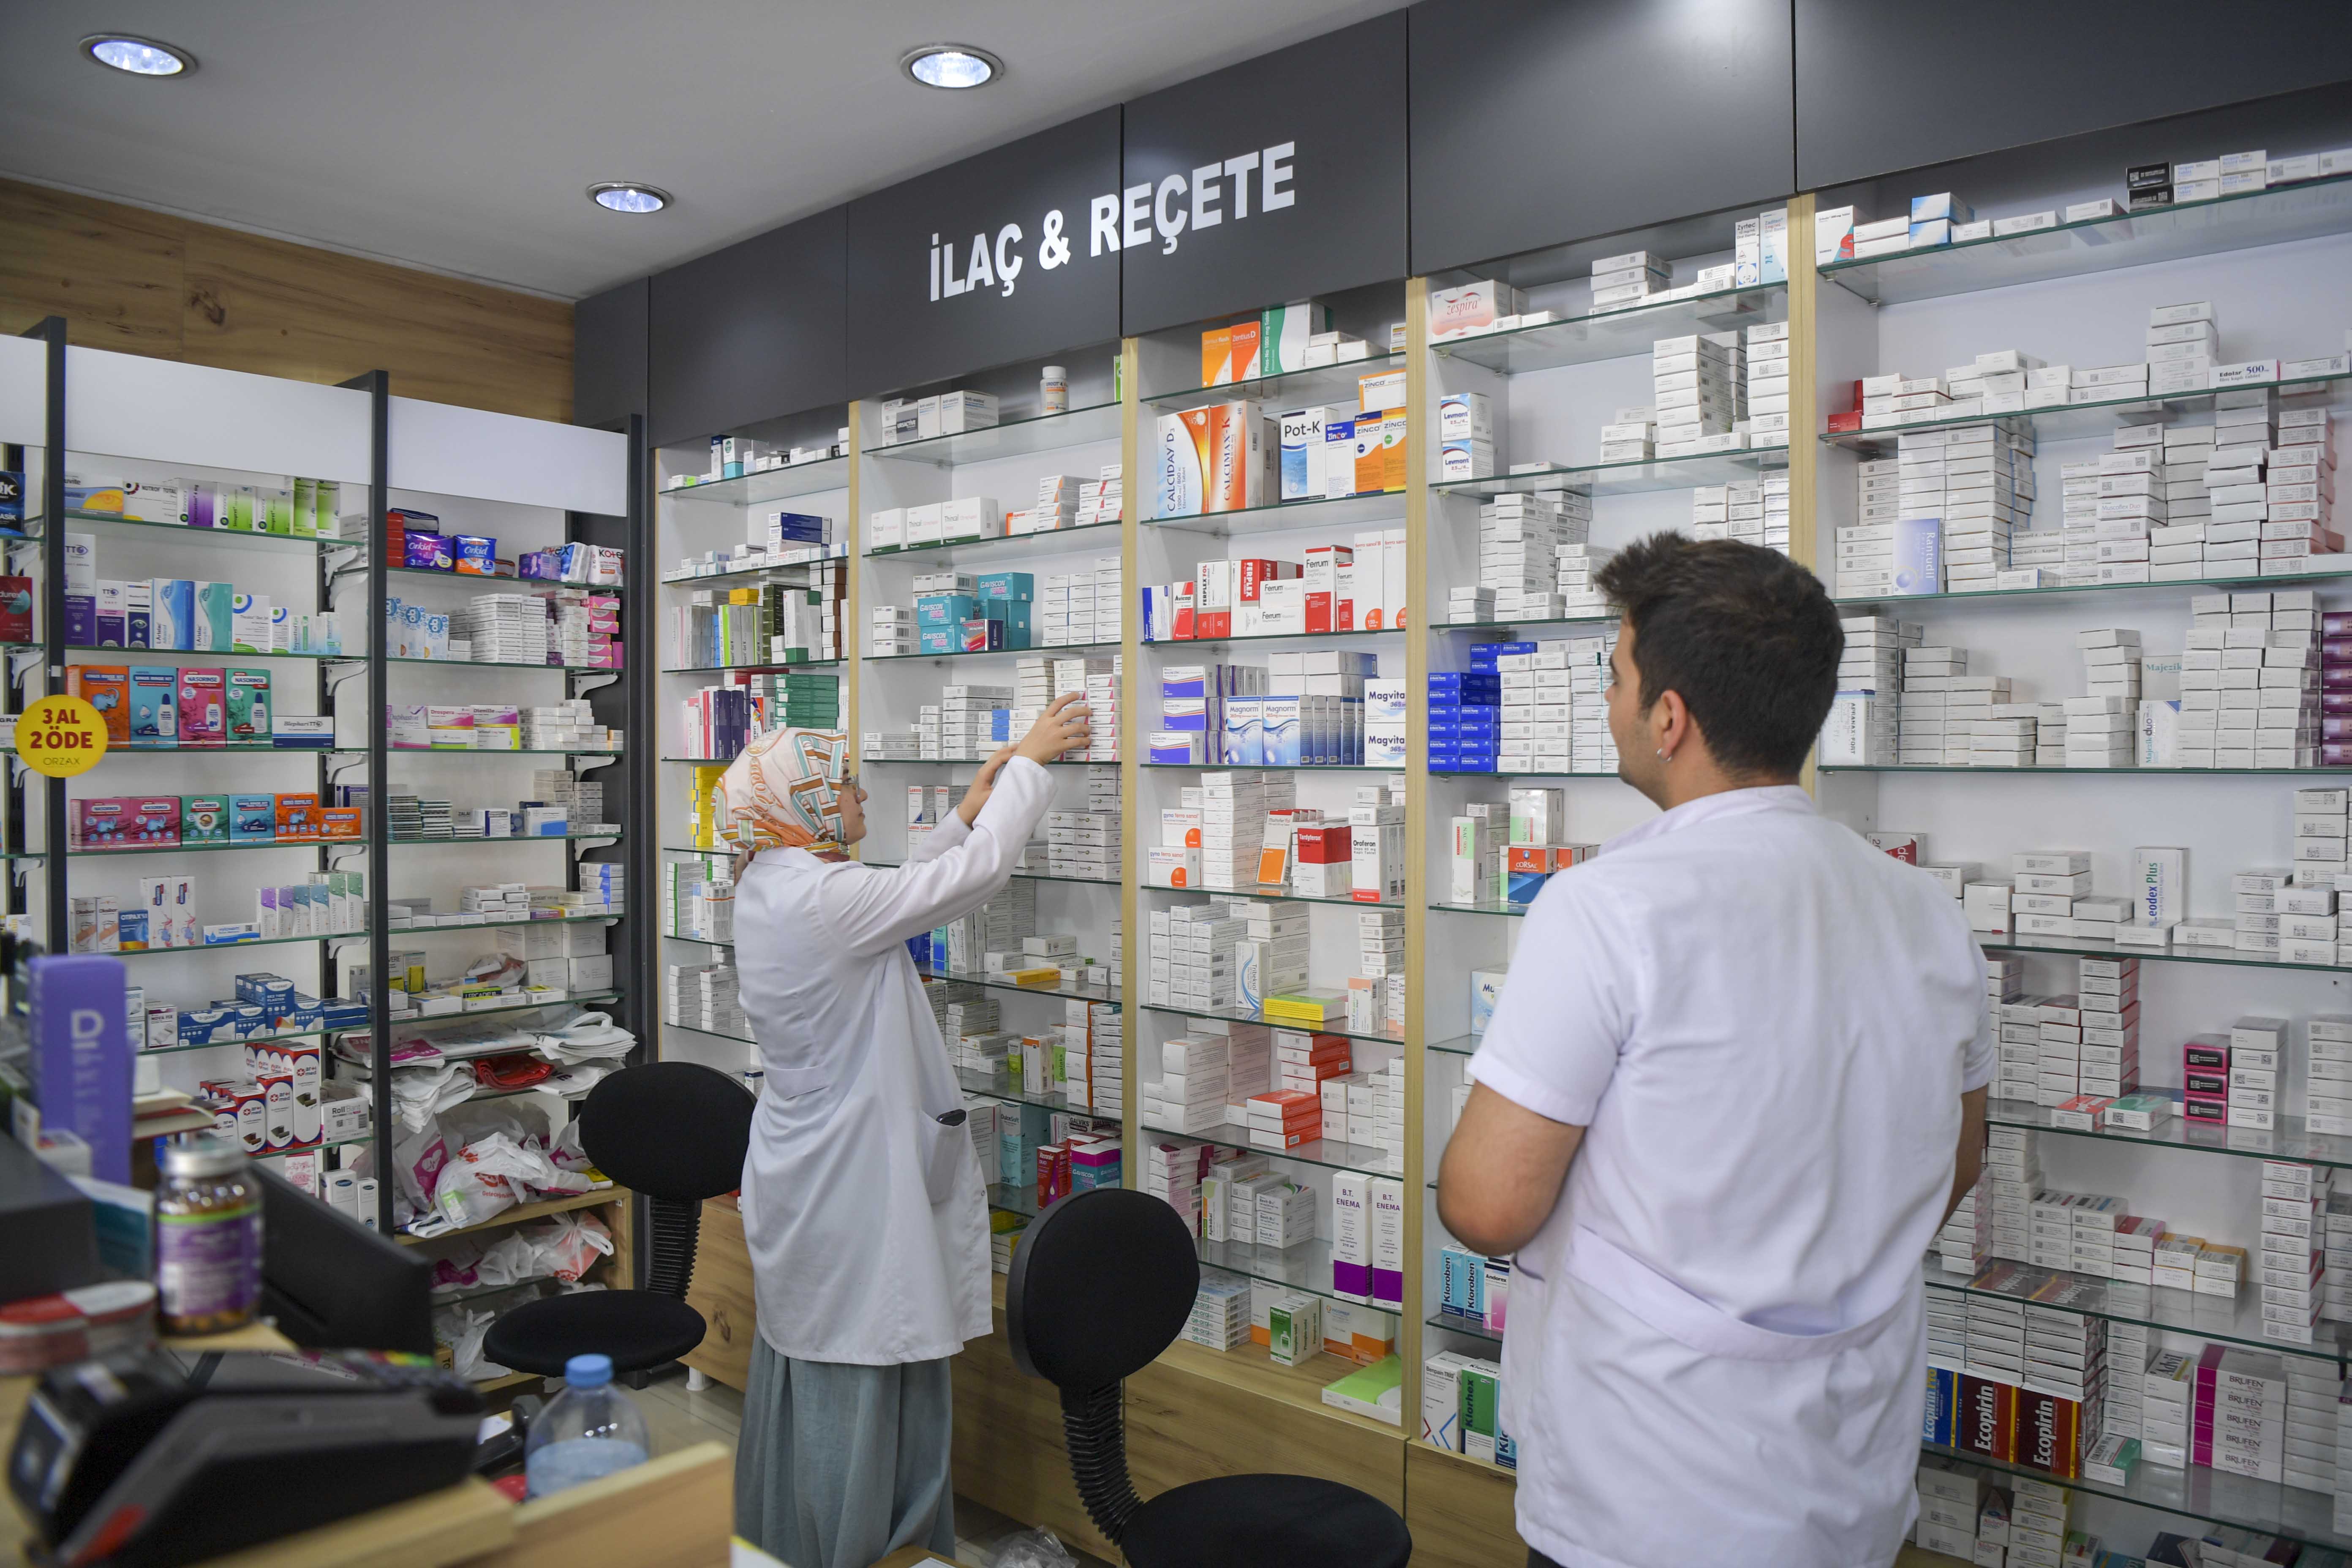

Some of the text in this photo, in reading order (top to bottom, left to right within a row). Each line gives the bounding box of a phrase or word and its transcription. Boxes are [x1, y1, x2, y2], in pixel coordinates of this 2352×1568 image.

[930, 141, 1295, 302] İLAÇ & REÇETE
[1737, 223, 1756, 231] Zyrtec
[1446, 298, 1478, 316] zespira
[2246, 365, 2264, 374] 500
[1444, 411, 1468, 419] Levmont
[1285, 421, 1320, 438] Pot-K
[1167, 448, 1175, 511] CALCIDAY
[408, 542, 431, 551] Orkid
[464, 546, 487, 556] Orkid
[1926, 532, 1936, 578] Rantudil
[1306, 559, 1328, 568] Ferrum
[920, 603, 943, 611] GAVISCON
[2146, 663, 2182, 672] Majezik
[1369, 690, 1405, 702] Magvita
[43, 708, 80, 725] 3 AL
[2142, 718, 2153, 736] duo
[30, 727, 93, 749] 2 ÖDE
[1368, 735, 1405, 746] Magvita
[43, 757, 81, 765] ORZAX
[2145, 863, 2157, 920] eodex Plus
[1001, 1113, 1020, 1123] DulceSoft
[1039, 1152, 1054, 1160] Rennie
[1073, 1169, 1094, 1179] GAVISCON
[1342, 1189, 1353, 1197] B.T.
[1336, 1198, 1360, 1209] ENEMA
[1376, 1203, 1400, 1211] ENEMA
[1486, 1274, 1507, 1282] Andorex
[1470, 1364, 1497, 1374] Klorhex
[2156, 1354, 2183, 1376] Advil
[2229, 1375, 2264, 1388] BRUFEN
[1465, 1379, 1474, 1427] Klorhex
[1924, 1369, 1938, 1439] Ecopirin Pro
[2228, 1394, 2262, 1407] BRUFEN
[1975, 1385, 1997, 1451] Ecopirin
[2227, 1414, 2261, 1427] BRUFEN
[2034, 1400, 2057, 1467] Ecopirin
[2226, 1434, 2260, 1447] BRUFEN
[2225, 1454, 2259, 1467] BRUFEN
